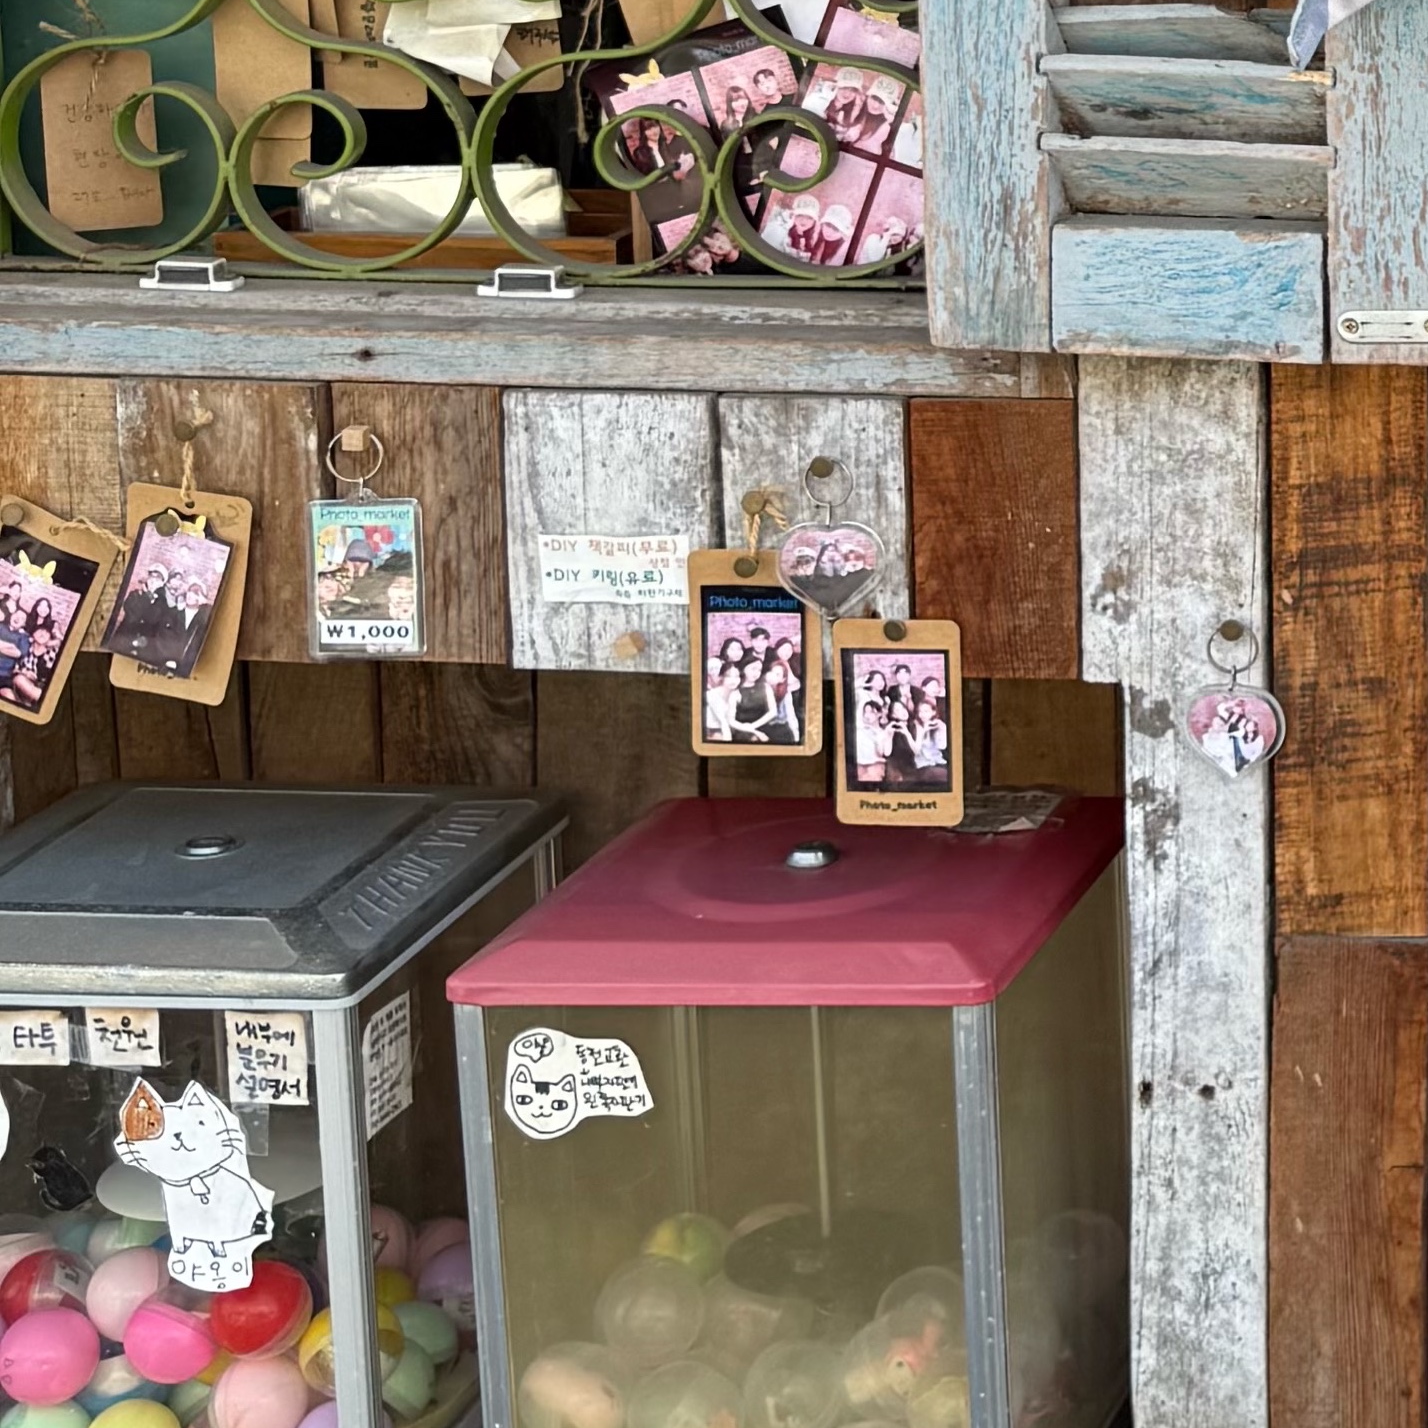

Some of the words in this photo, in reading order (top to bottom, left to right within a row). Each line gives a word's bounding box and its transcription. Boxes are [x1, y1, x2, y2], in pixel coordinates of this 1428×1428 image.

[551, 539, 578, 552] DIY
[588, 539, 678, 556] 책갈피(무료)
[553, 568, 581, 582] DIY
[592, 569, 664, 587] 키링(유료)
[327, 624, 410, 640] ₩1,000
[13, 1022, 57, 1056] 타투
[93, 1015, 154, 1053] 천원
[235, 1020, 295, 1047] 내부에
